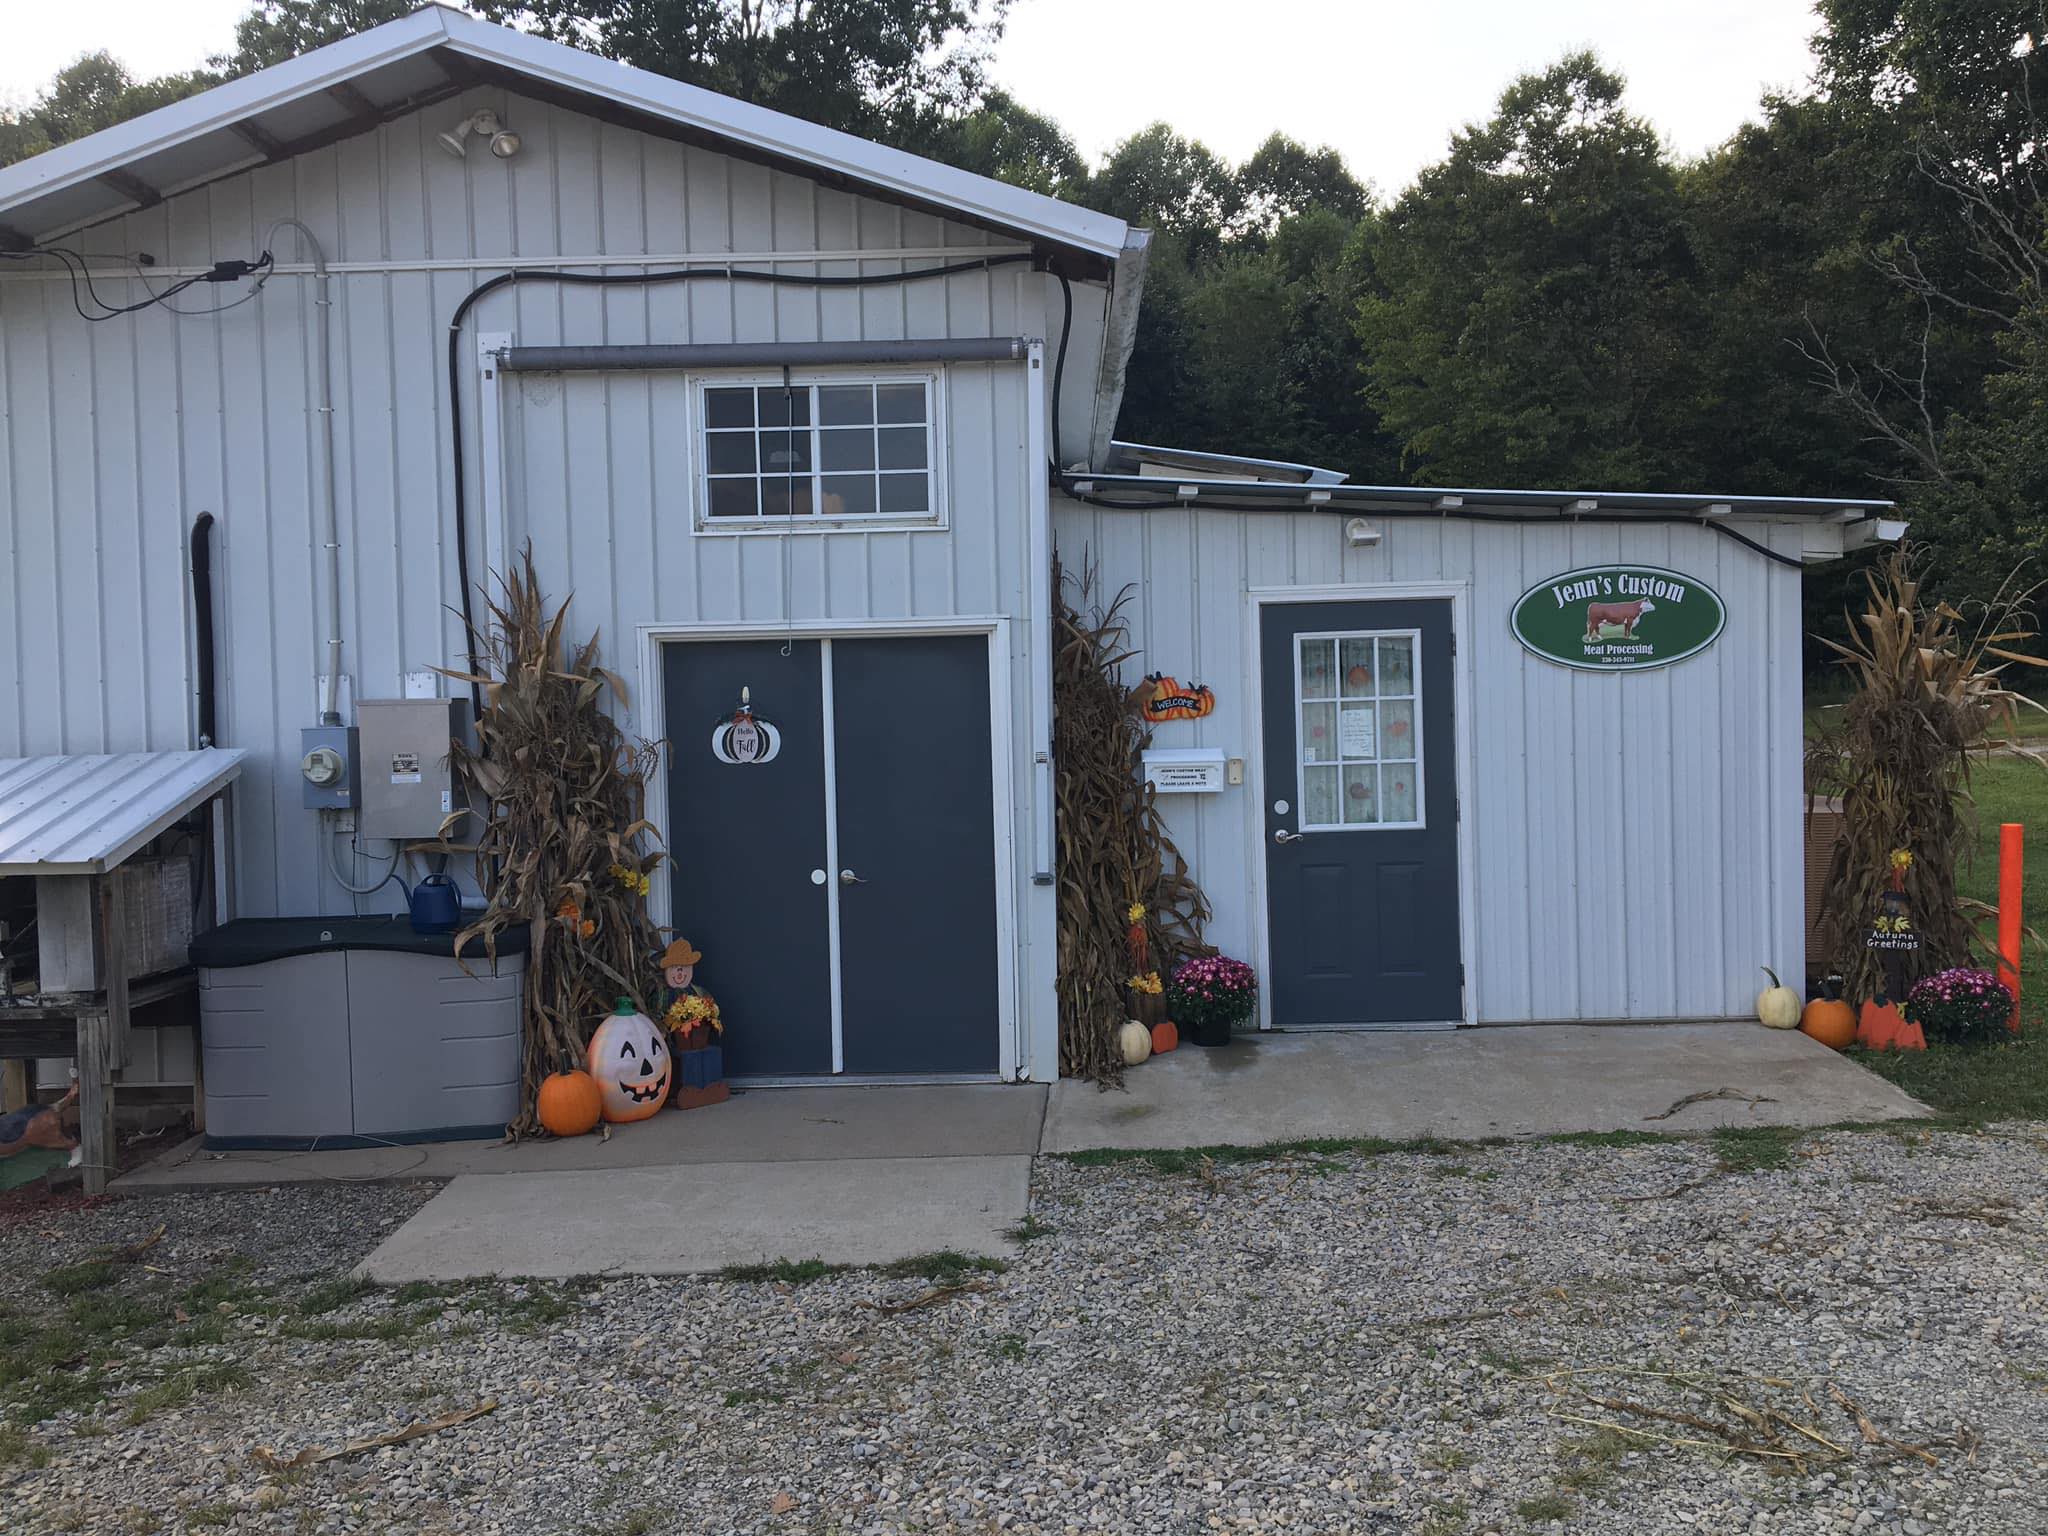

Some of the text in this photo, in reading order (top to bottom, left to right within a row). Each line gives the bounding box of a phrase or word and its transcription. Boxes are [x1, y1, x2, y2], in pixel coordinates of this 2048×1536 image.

[1552, 574, 1685, 609] Jenn's Custom
[1584, 643, 1653, 656] Meat Processing
[1157, 698, 1194, 710] WELCOME
[737, 727, 754, 735] Hello
[1872, 930, 1914, 940] Autumn
[1867, 938, 1918, 950] Greetings
